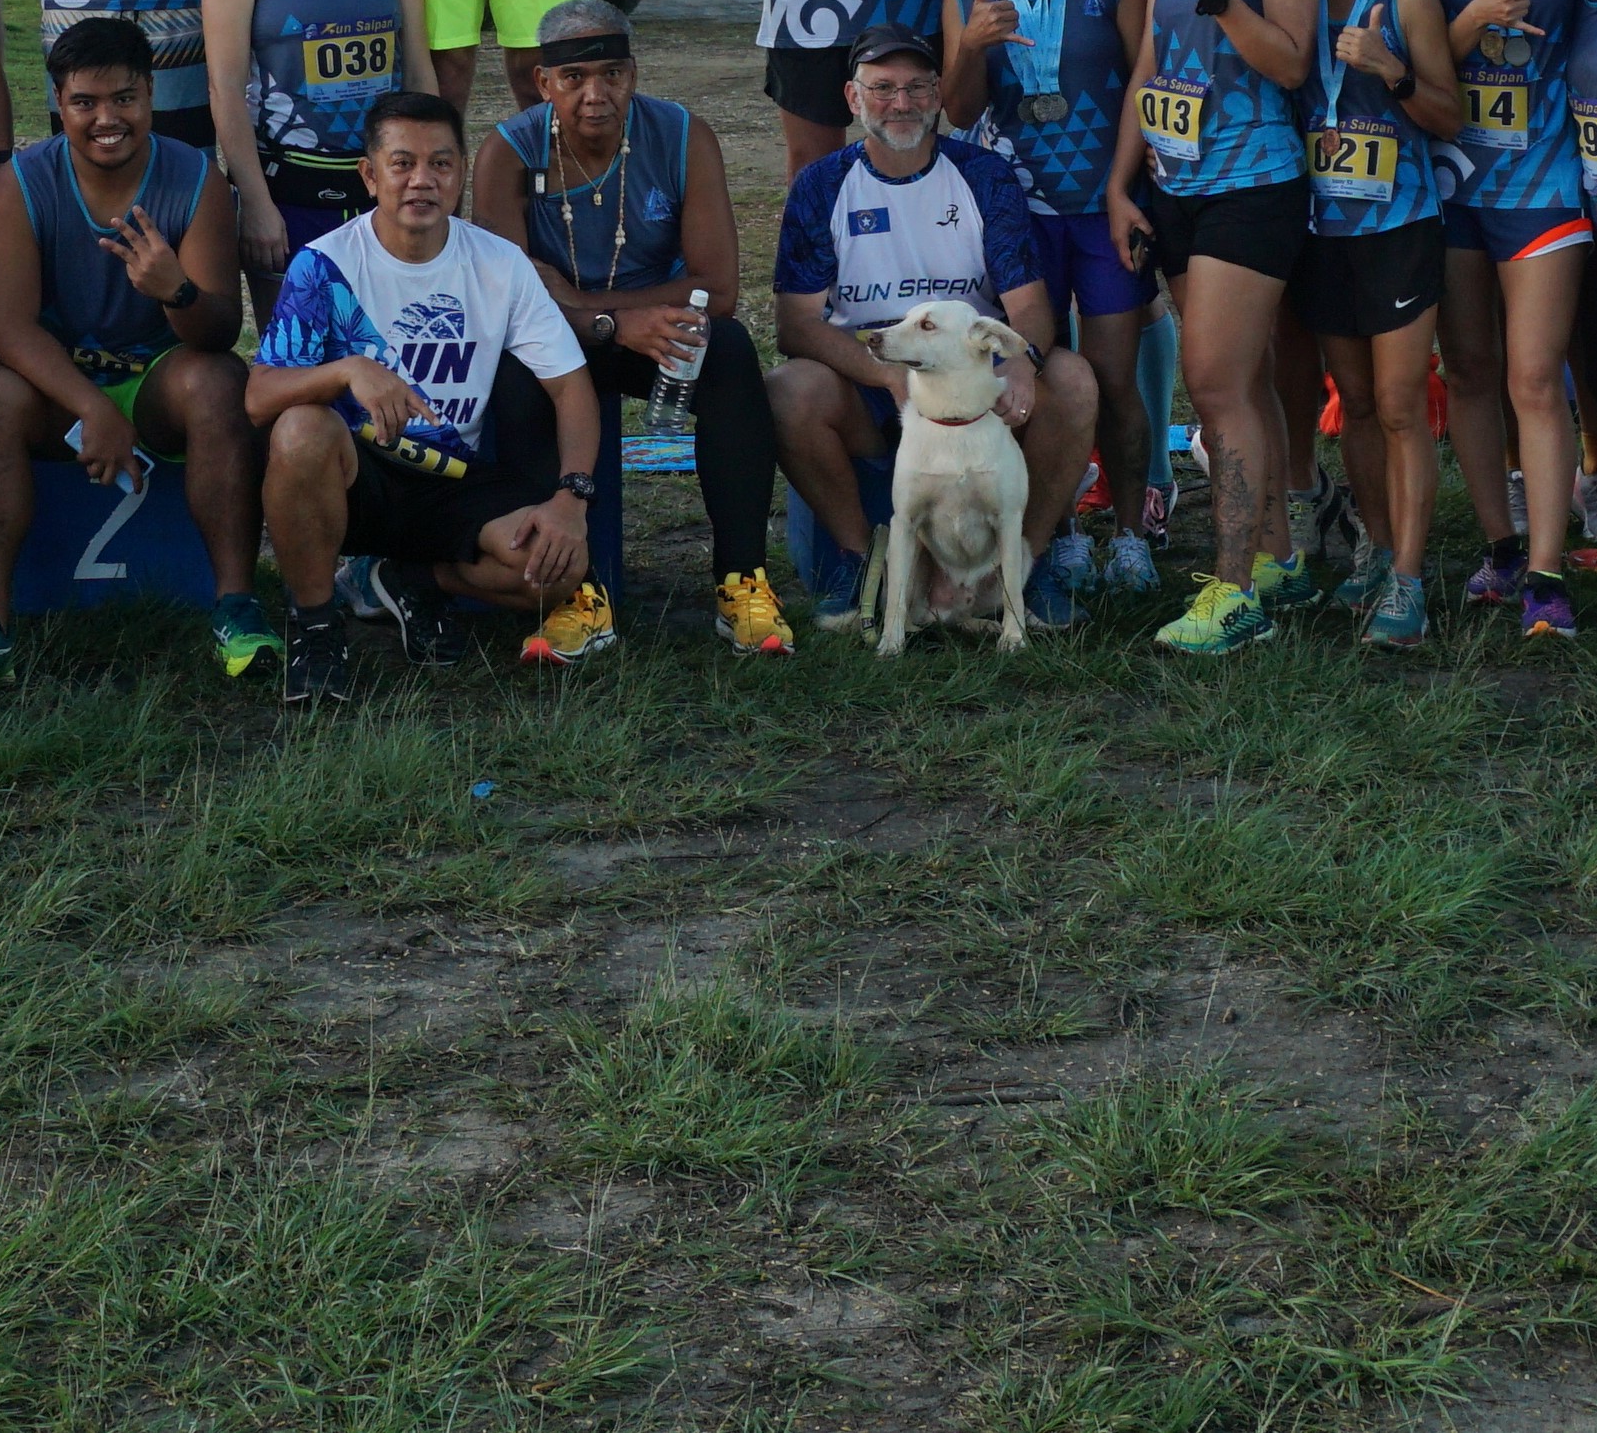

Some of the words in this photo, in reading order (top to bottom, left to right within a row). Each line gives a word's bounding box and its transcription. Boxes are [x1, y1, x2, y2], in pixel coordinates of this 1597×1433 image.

[356, 19, 394, 32] Saipan
[317, 37, 387, 78] 038
[1169, 78, 1204, 95] Saipan
[1477, 71, 1524, 85] Saipan
[1142, 92, 1191, 136] 013
[1467, 89, 1516, 126] 14
[1349, 118, 1394, 134] Saipan
[1314, 137, 1380, 176] 021
[838, 282, 892, 303] RUN
[73, 475, 150, 580] 2
